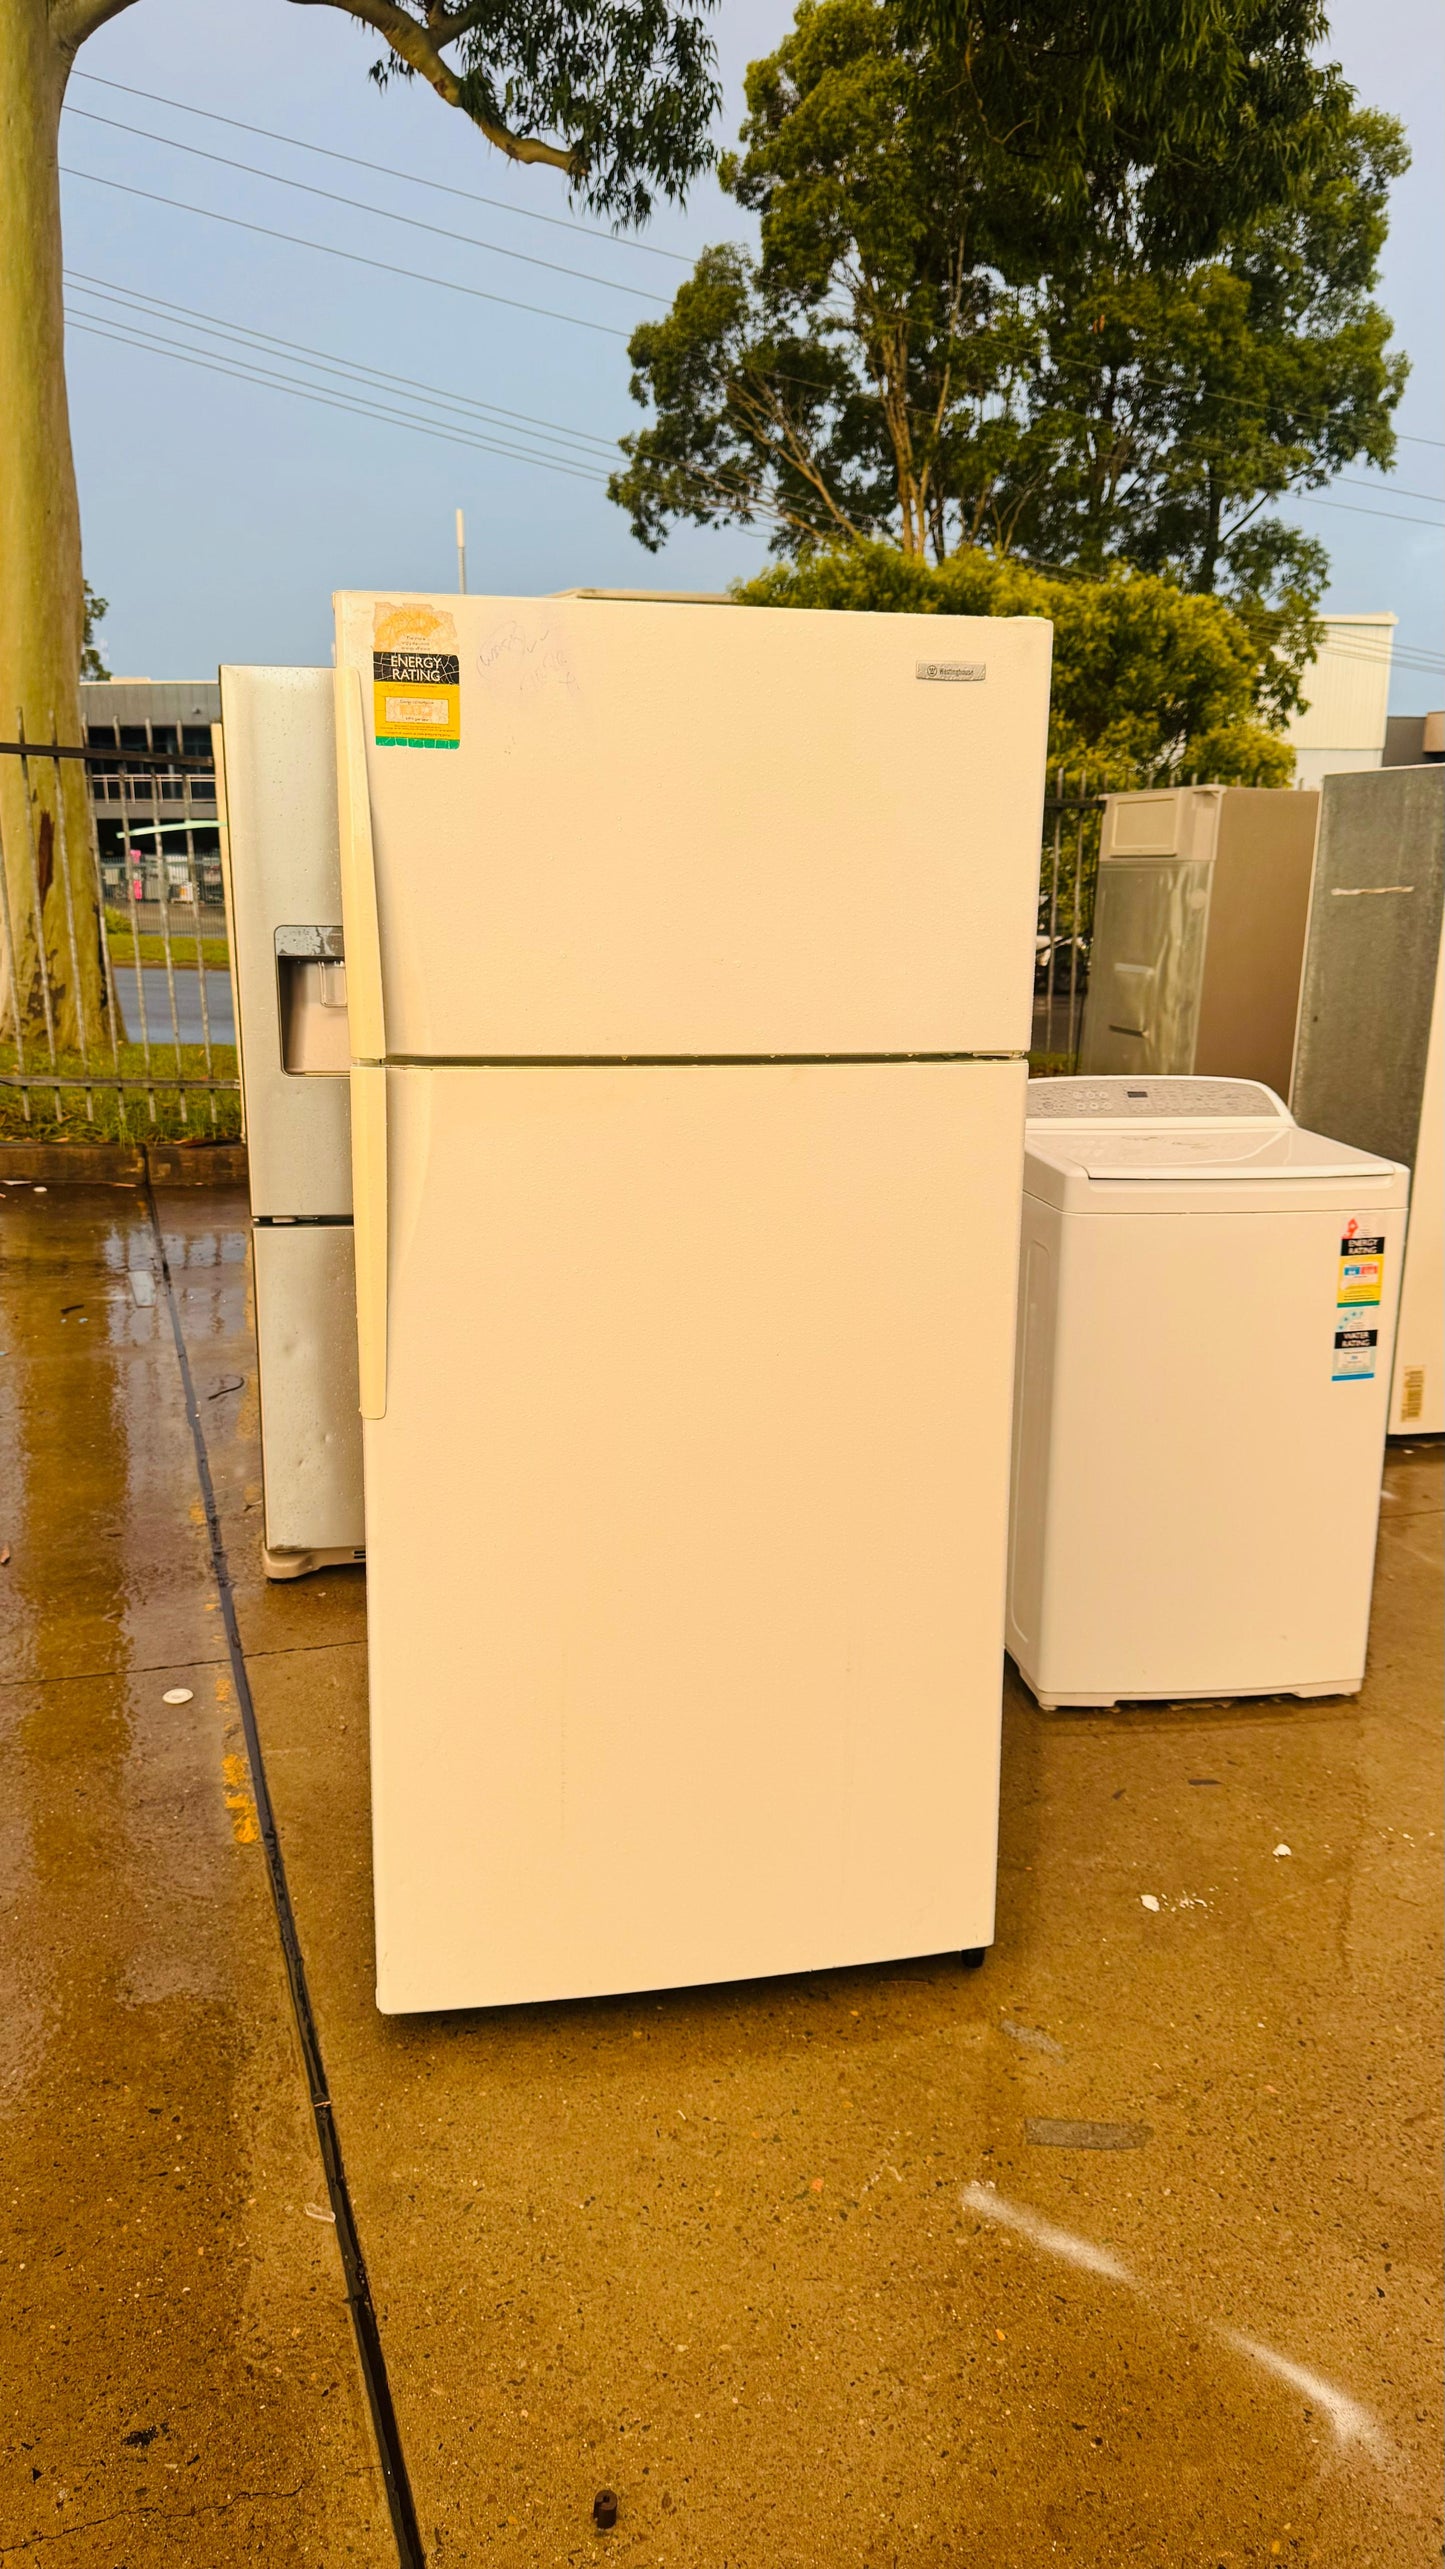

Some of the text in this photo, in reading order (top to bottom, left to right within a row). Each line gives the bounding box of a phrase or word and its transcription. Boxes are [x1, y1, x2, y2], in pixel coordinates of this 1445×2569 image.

[391, 654, 442, 670] ENERGY
[392, 668, 441, 682] RATING
[1348, 1238, 1378, 1247] ENERGY
[1347, 1246, 1377, 1255] RATING
[1343, 1331, 1369, 1339] WATER
[1341, 1339, 1371, 1347] RATING
